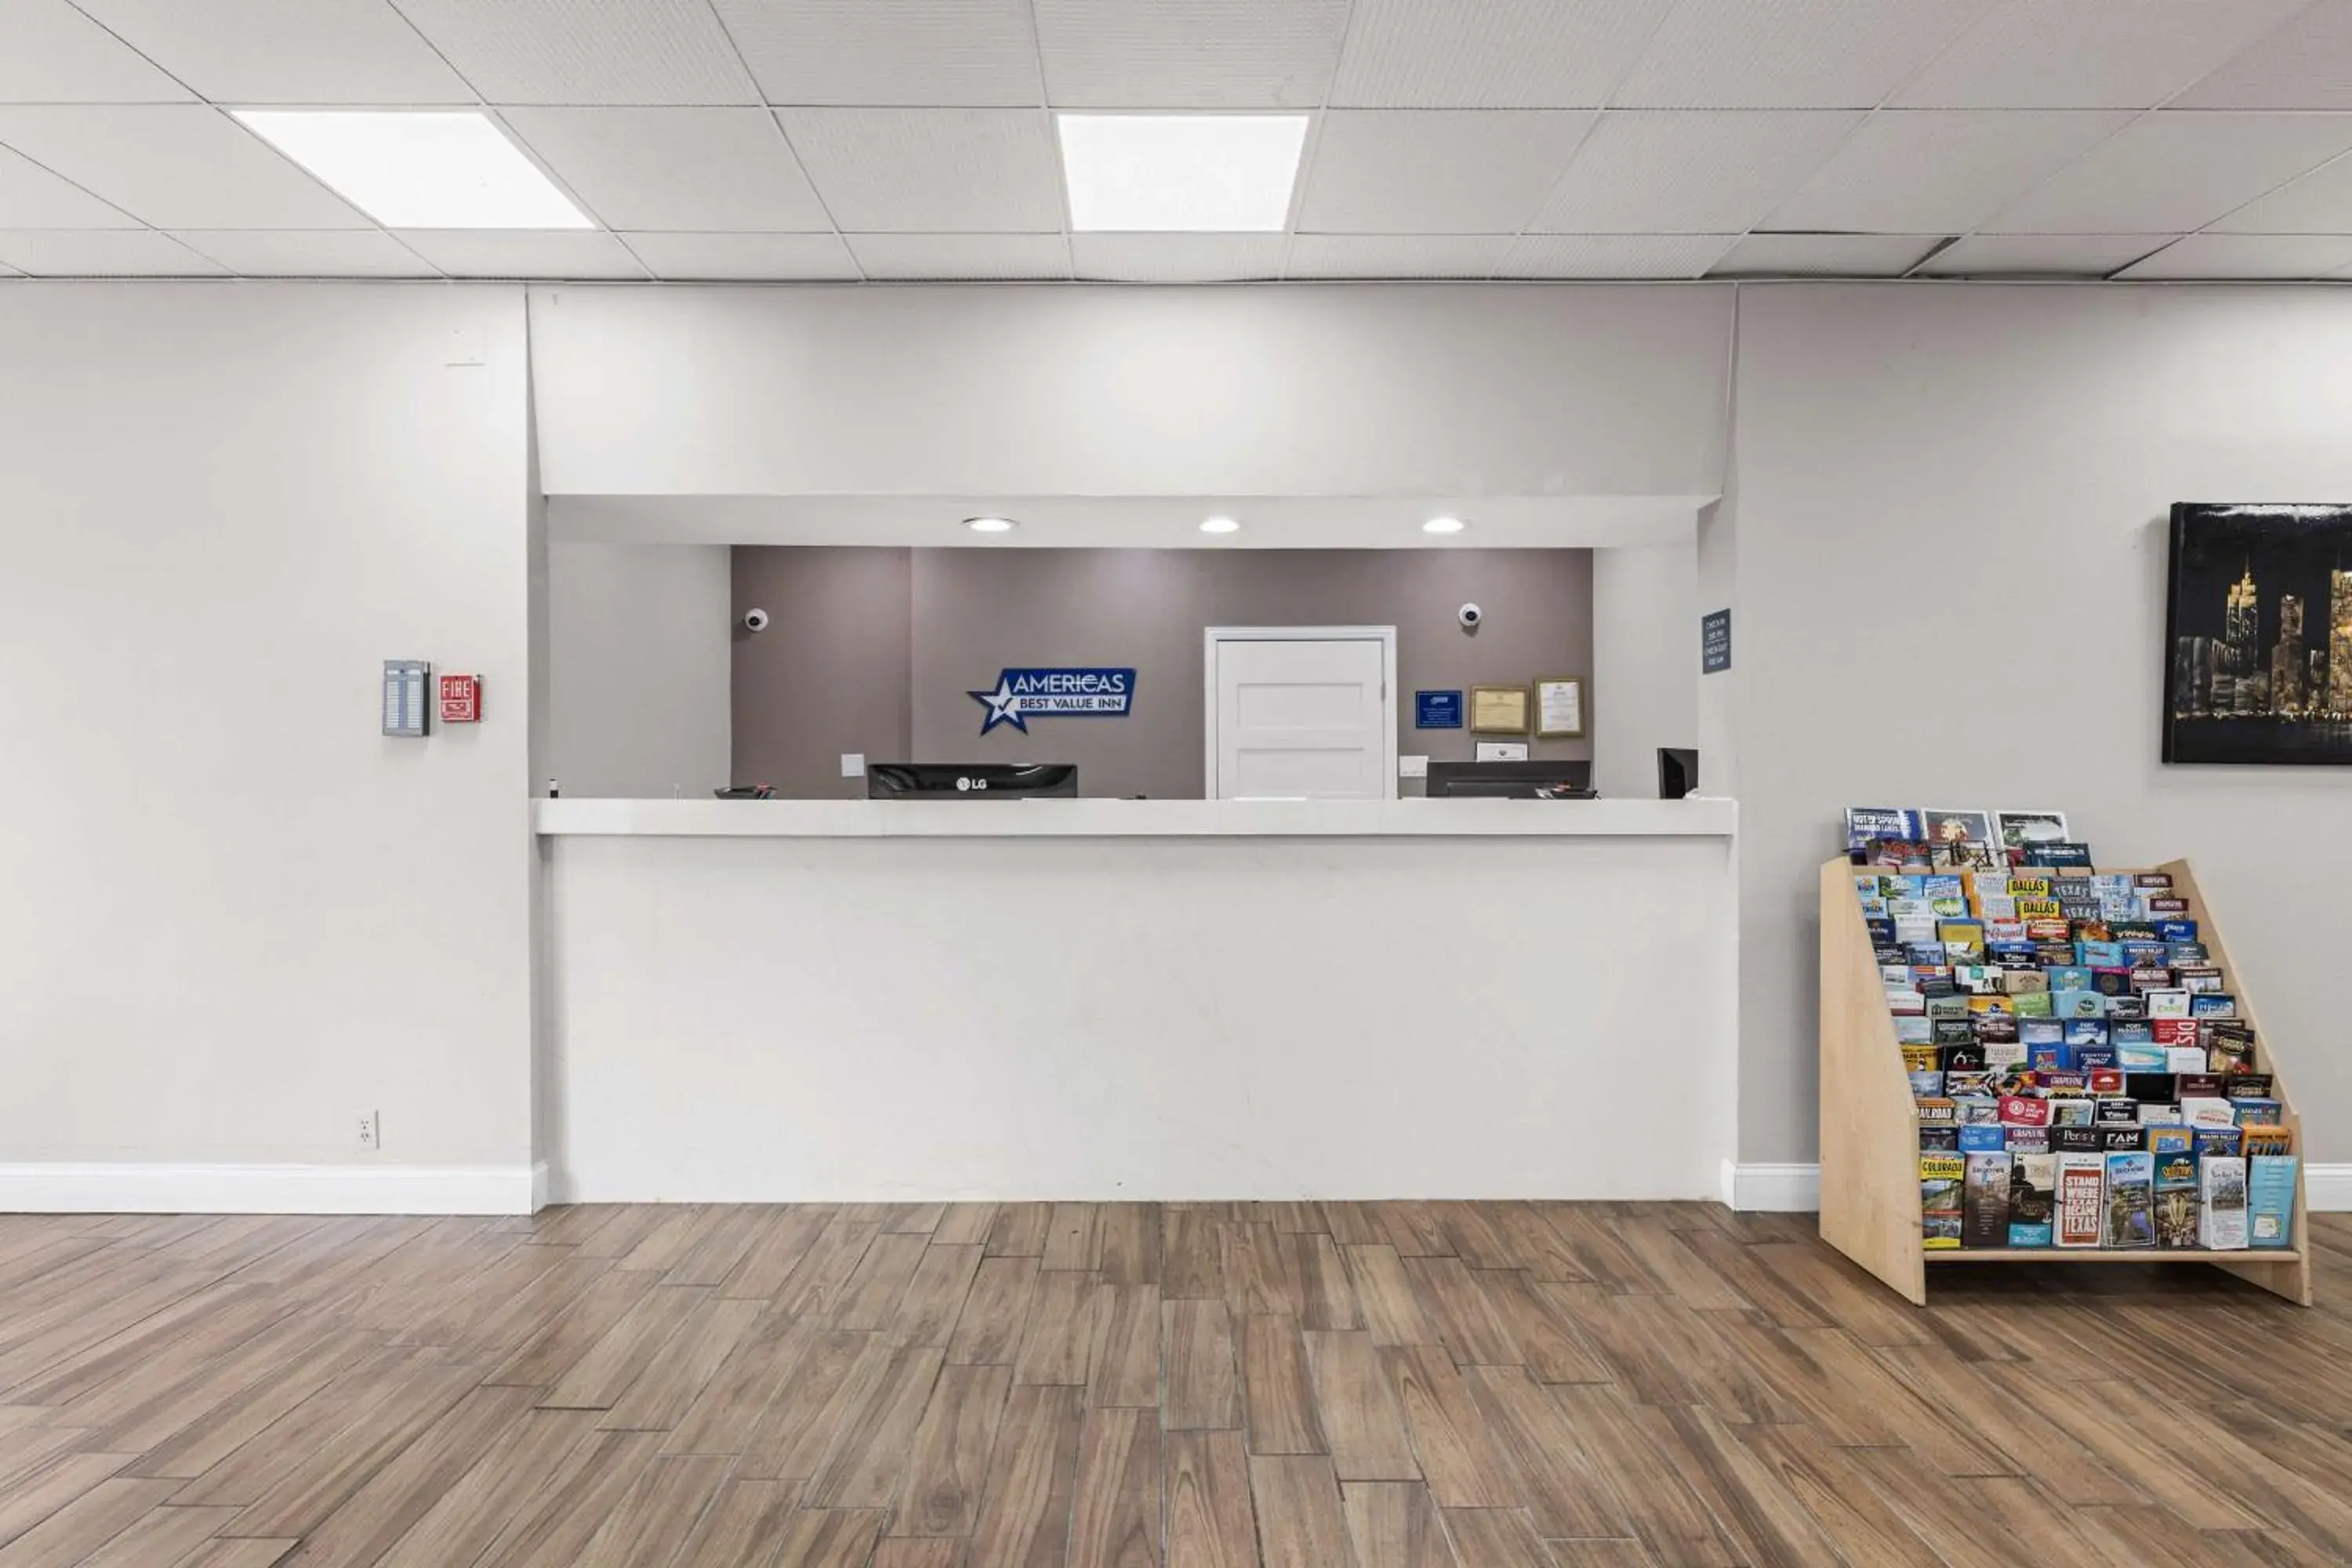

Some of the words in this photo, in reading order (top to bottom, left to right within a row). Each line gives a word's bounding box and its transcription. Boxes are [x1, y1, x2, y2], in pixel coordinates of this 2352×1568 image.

[1013, 673, 1125, 693] AMERICAS
[441, 681, 471, 698] FIRE
[1020, 698, 1050, 709] BEST
[1054, 698, 1093, 709] VALUE
[1098, 698, 1122, 709] INN
[971, 779, 987, 789] LG
[2013, 880, 2045, 891] DALLAS
[2053, 884, 2089, 898] TEXAS
[2024, 902, 2055, 913] DALLAS
[2064, 906, 2099, 919] TEXAS
[1922, 1160, 1962, 1172] COLORADO
[2064, 1176, 2100, 1186] STAND
[2065, 1188, 2099, 1199] WHERE
[2064, 1204, 2098, 1216] BECAME
[2064, 1216, 2097, 1233] TEXAS
